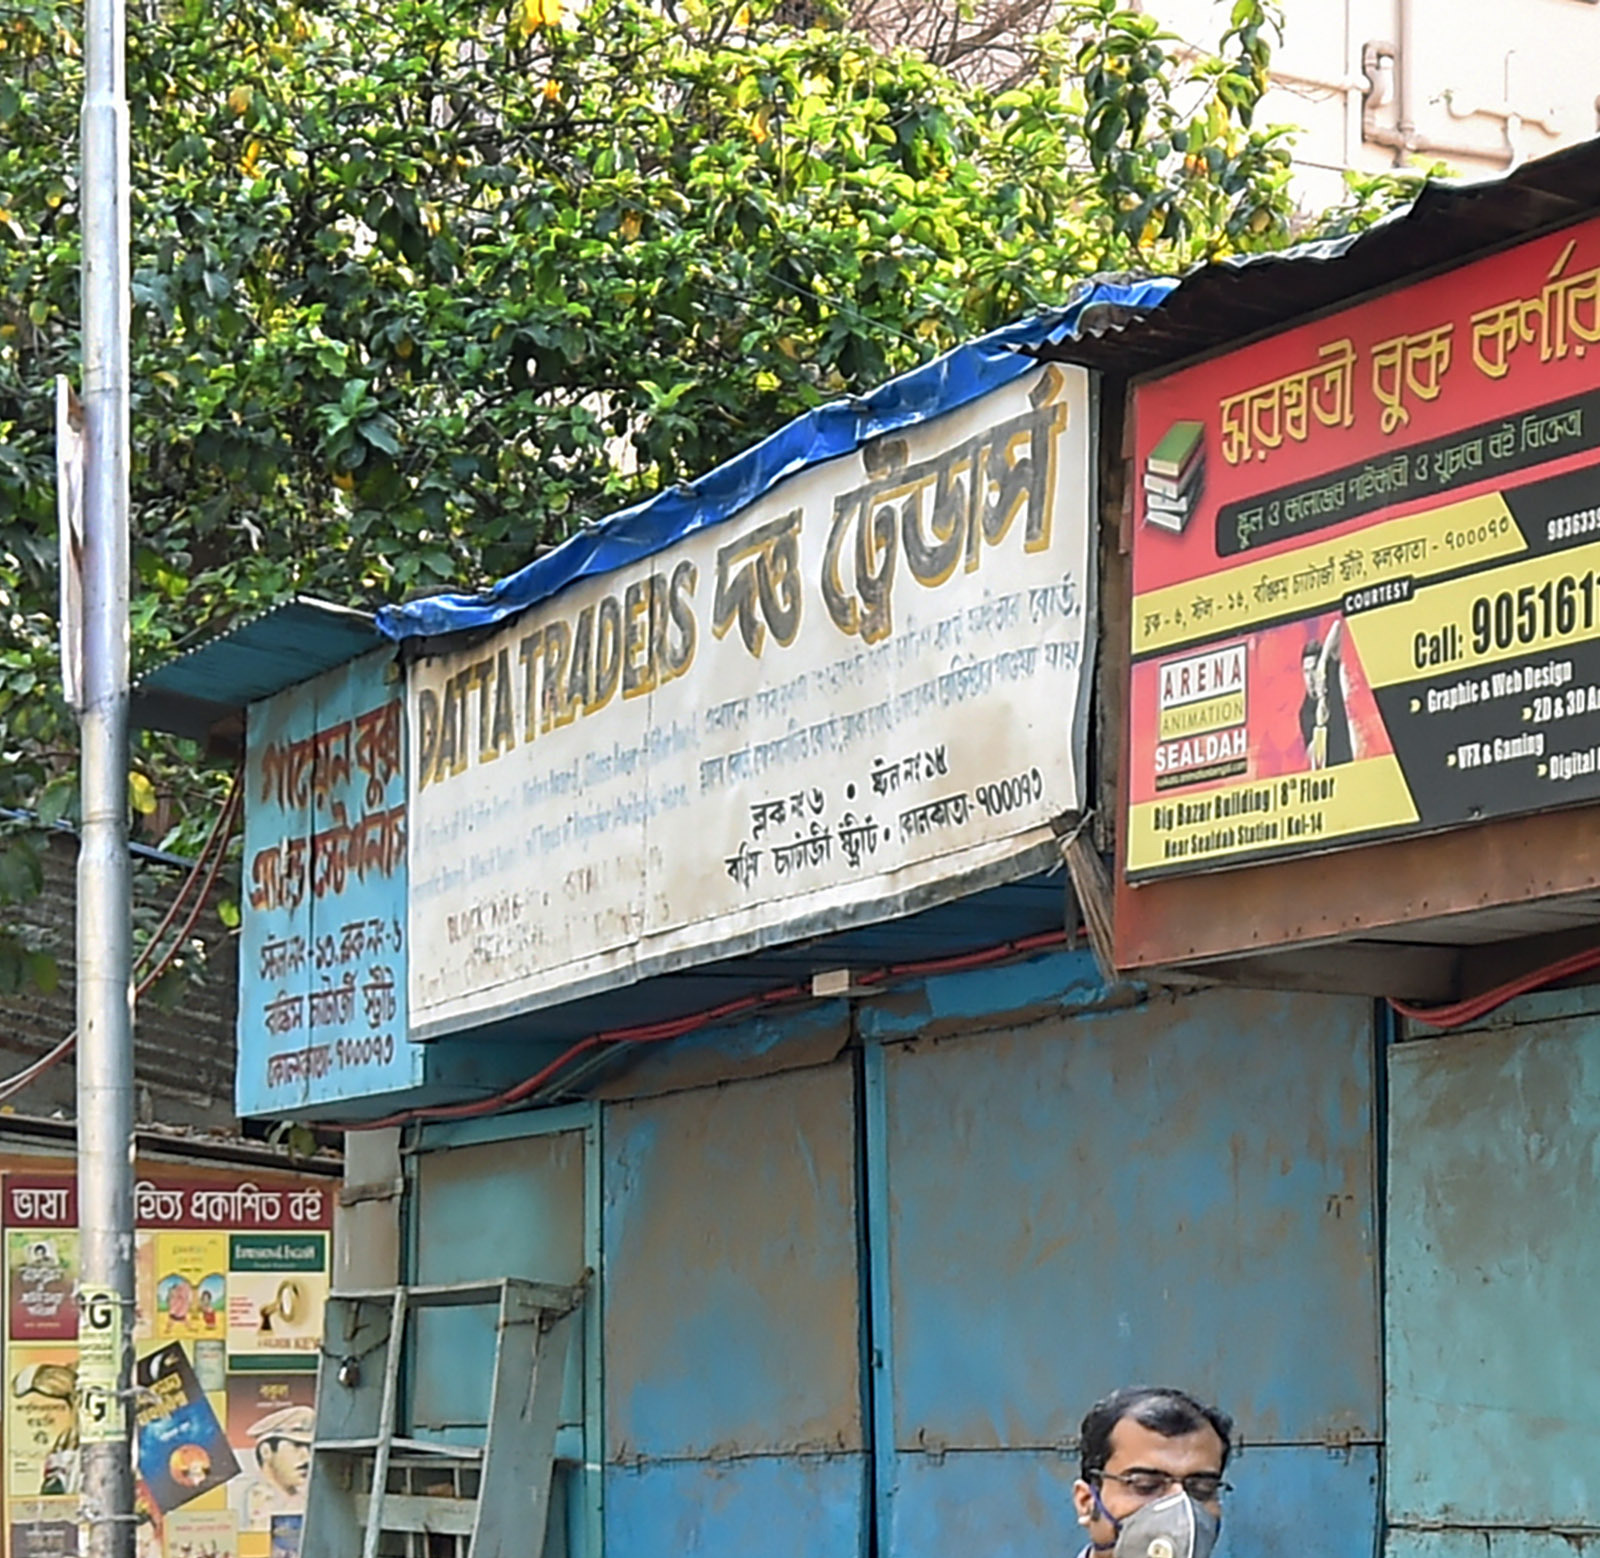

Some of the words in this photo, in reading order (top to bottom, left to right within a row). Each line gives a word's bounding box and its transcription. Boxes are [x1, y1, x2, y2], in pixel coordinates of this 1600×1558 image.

[1220, 338, 1357, 465] সরস্বতী
[1371, 322, 1454, 433] বুক
[1267, 501, 1280, 526] ও
[1284, 480, 1346, 522] কলেজের
[1349, 455, 1409, 500] পাইকারী
[1415, 454, 1429, 480] ও
[1489, 423, 1517, 458] বই
[1520, 409, 1583, 452] বিক্রেতা
[1371, 538, 1427, 570] কলকাতা
[711, 506, 804, 659] দত্ত
[1345, 580, 1410, 612] COURTESY
[1414, 624, 1463, 669] Call:
[418, 646, 515, 793] DATTA
[519, 559, 698, 743] TRADERS
[1163, 653, 1242, 701] ARENA
[1426, 680, 1479, 713] Graphic
[1492, 669, 1522, 699] Web
[1524, 660, 1572, 691] Design
[1162, 701, 1243, 732] ANIMATION
[1532, 697, 1552, 723] 2D
[1566, 690, 1585, 716] 3D
[1155, 728, 1247, 772] SEALDAH
[1458, 743, 1482, 769] VFX
[1494, 733, 1544, 761] Gaming
[1549, 748, 1595, 780] Digital
[1154, 806, 1174, 831] Big
[1177, 800, 1213, 827] Bazar
[1214, 788, 1270, 819] Building
[1299, 777, 1335, 804] Floor
[1164, 838, 1189, 859] Near
[1191, 828, 1235, 850] Sealdah
[1238, 821, 1278, 845] Station
[1287, 811, 1323, 837] Kol-14
[11, 1188, 69, 1221] ভাষা
[134, 1181, 184, 1221] হিত্য
[190, 1181, 281, 1222] প্রকাশিত
[288, 1182, 323, 1221] বই
